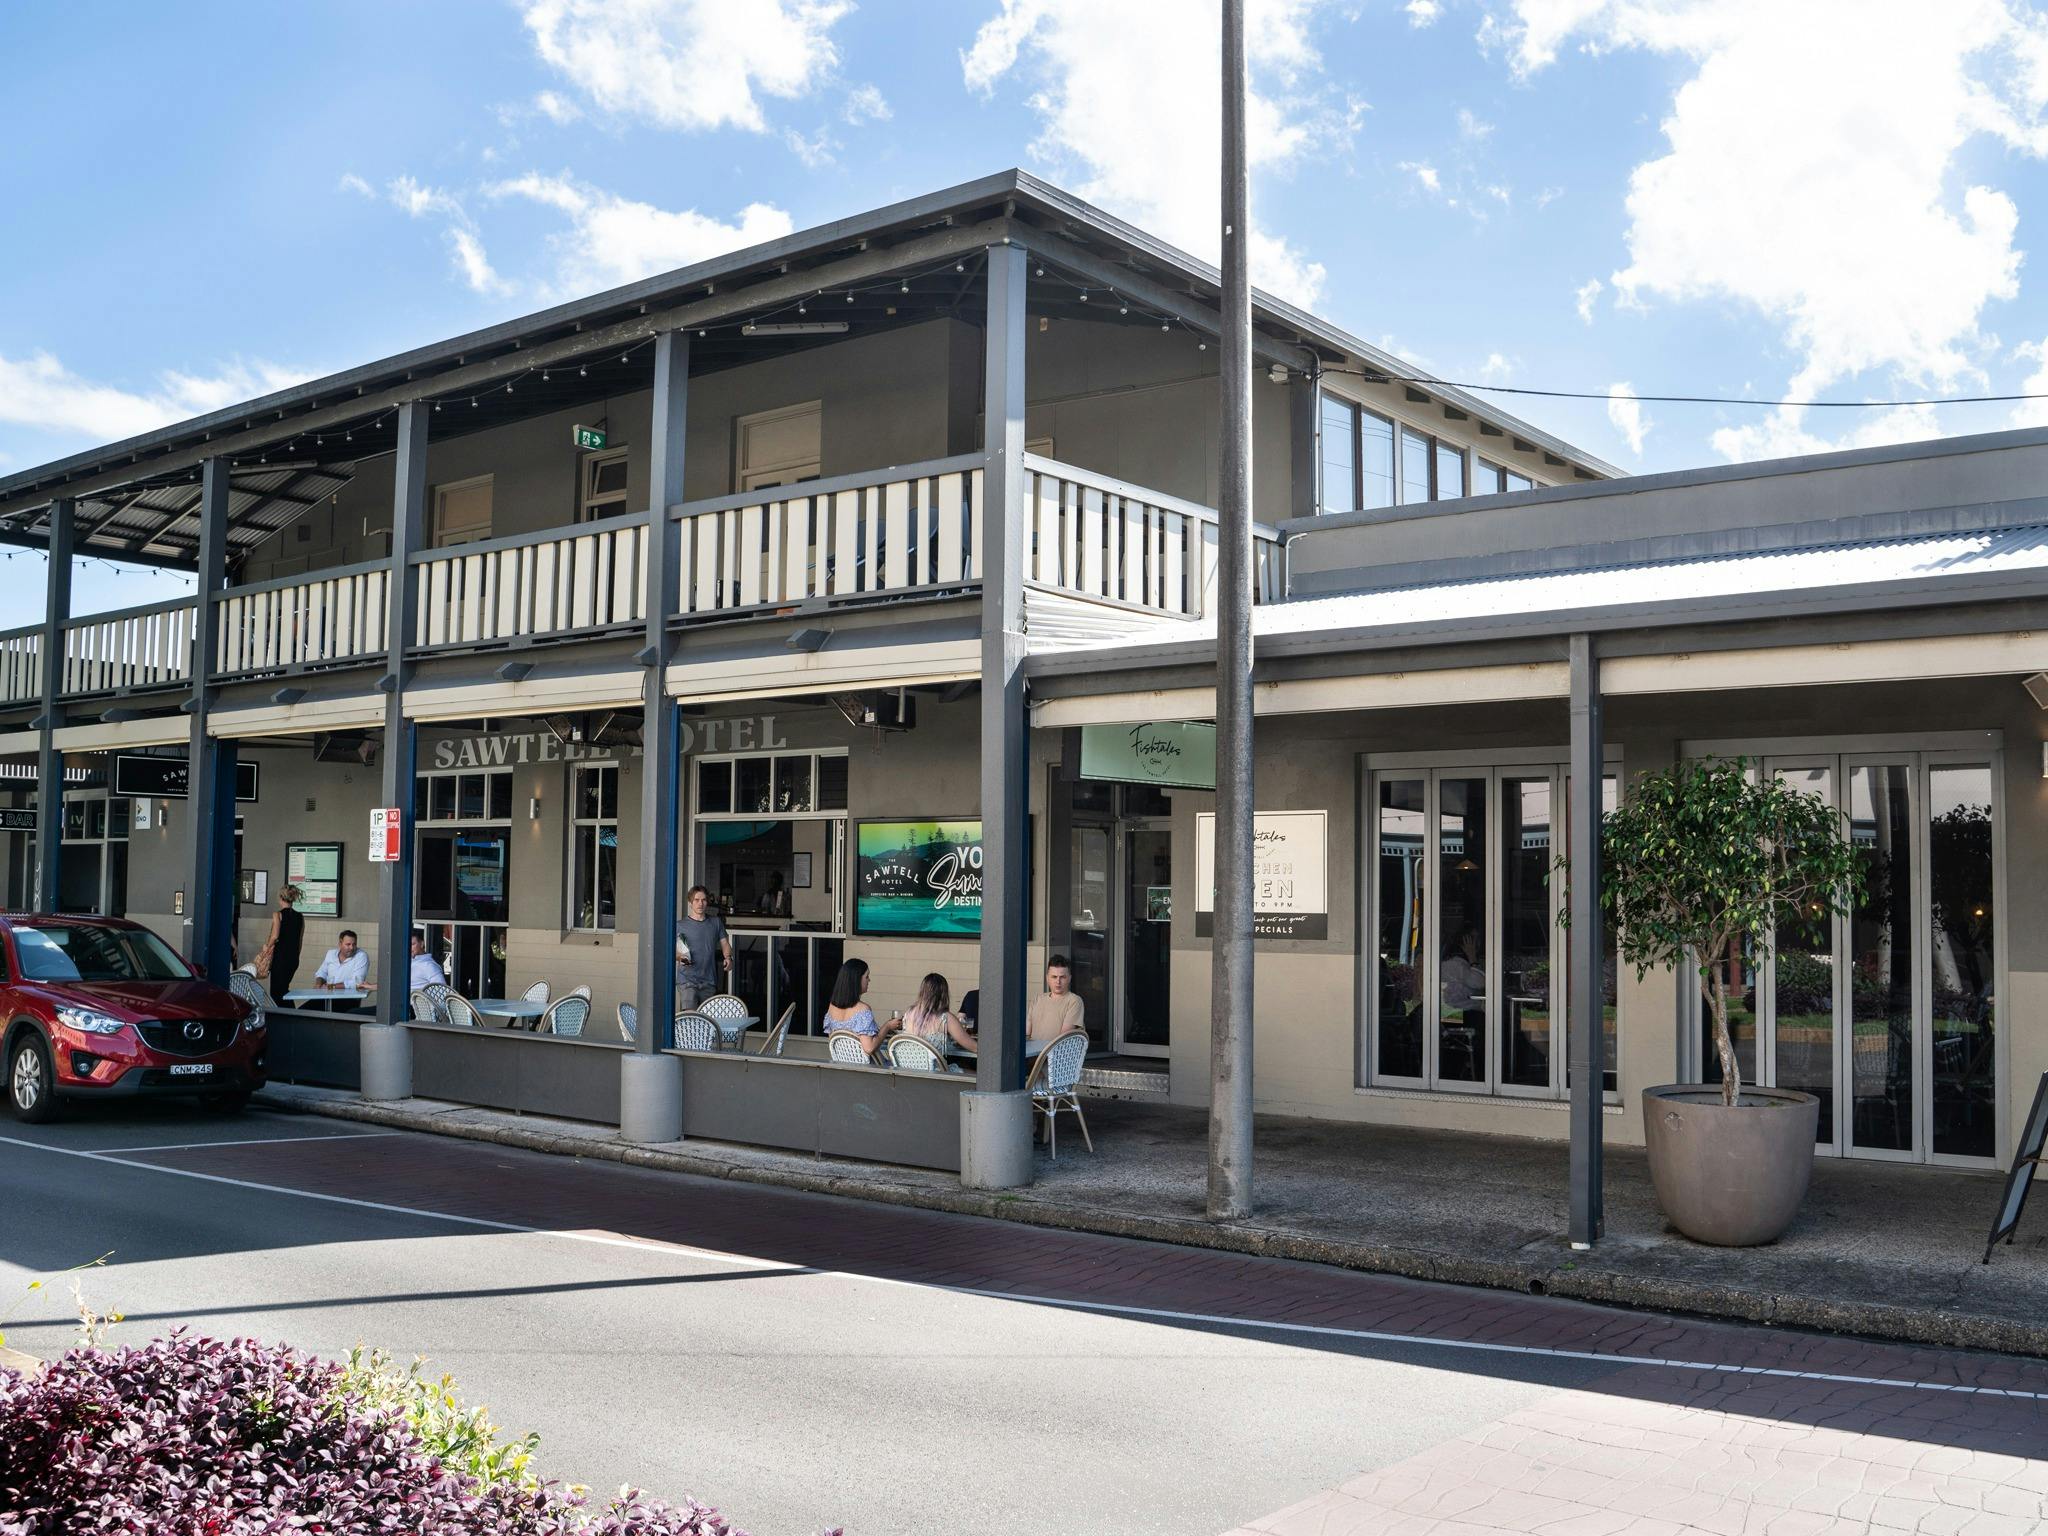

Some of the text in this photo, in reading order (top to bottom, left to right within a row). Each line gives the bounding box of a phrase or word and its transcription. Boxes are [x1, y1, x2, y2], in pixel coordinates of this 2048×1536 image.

[1129, 722, 1181, 757] Fishtales
[6, 813, 34, 827] BAR
[373, 812, 384, 825] 1P
[389, 811, 398, 820] NO
[865, 865, 919, 884] SAWTELL
